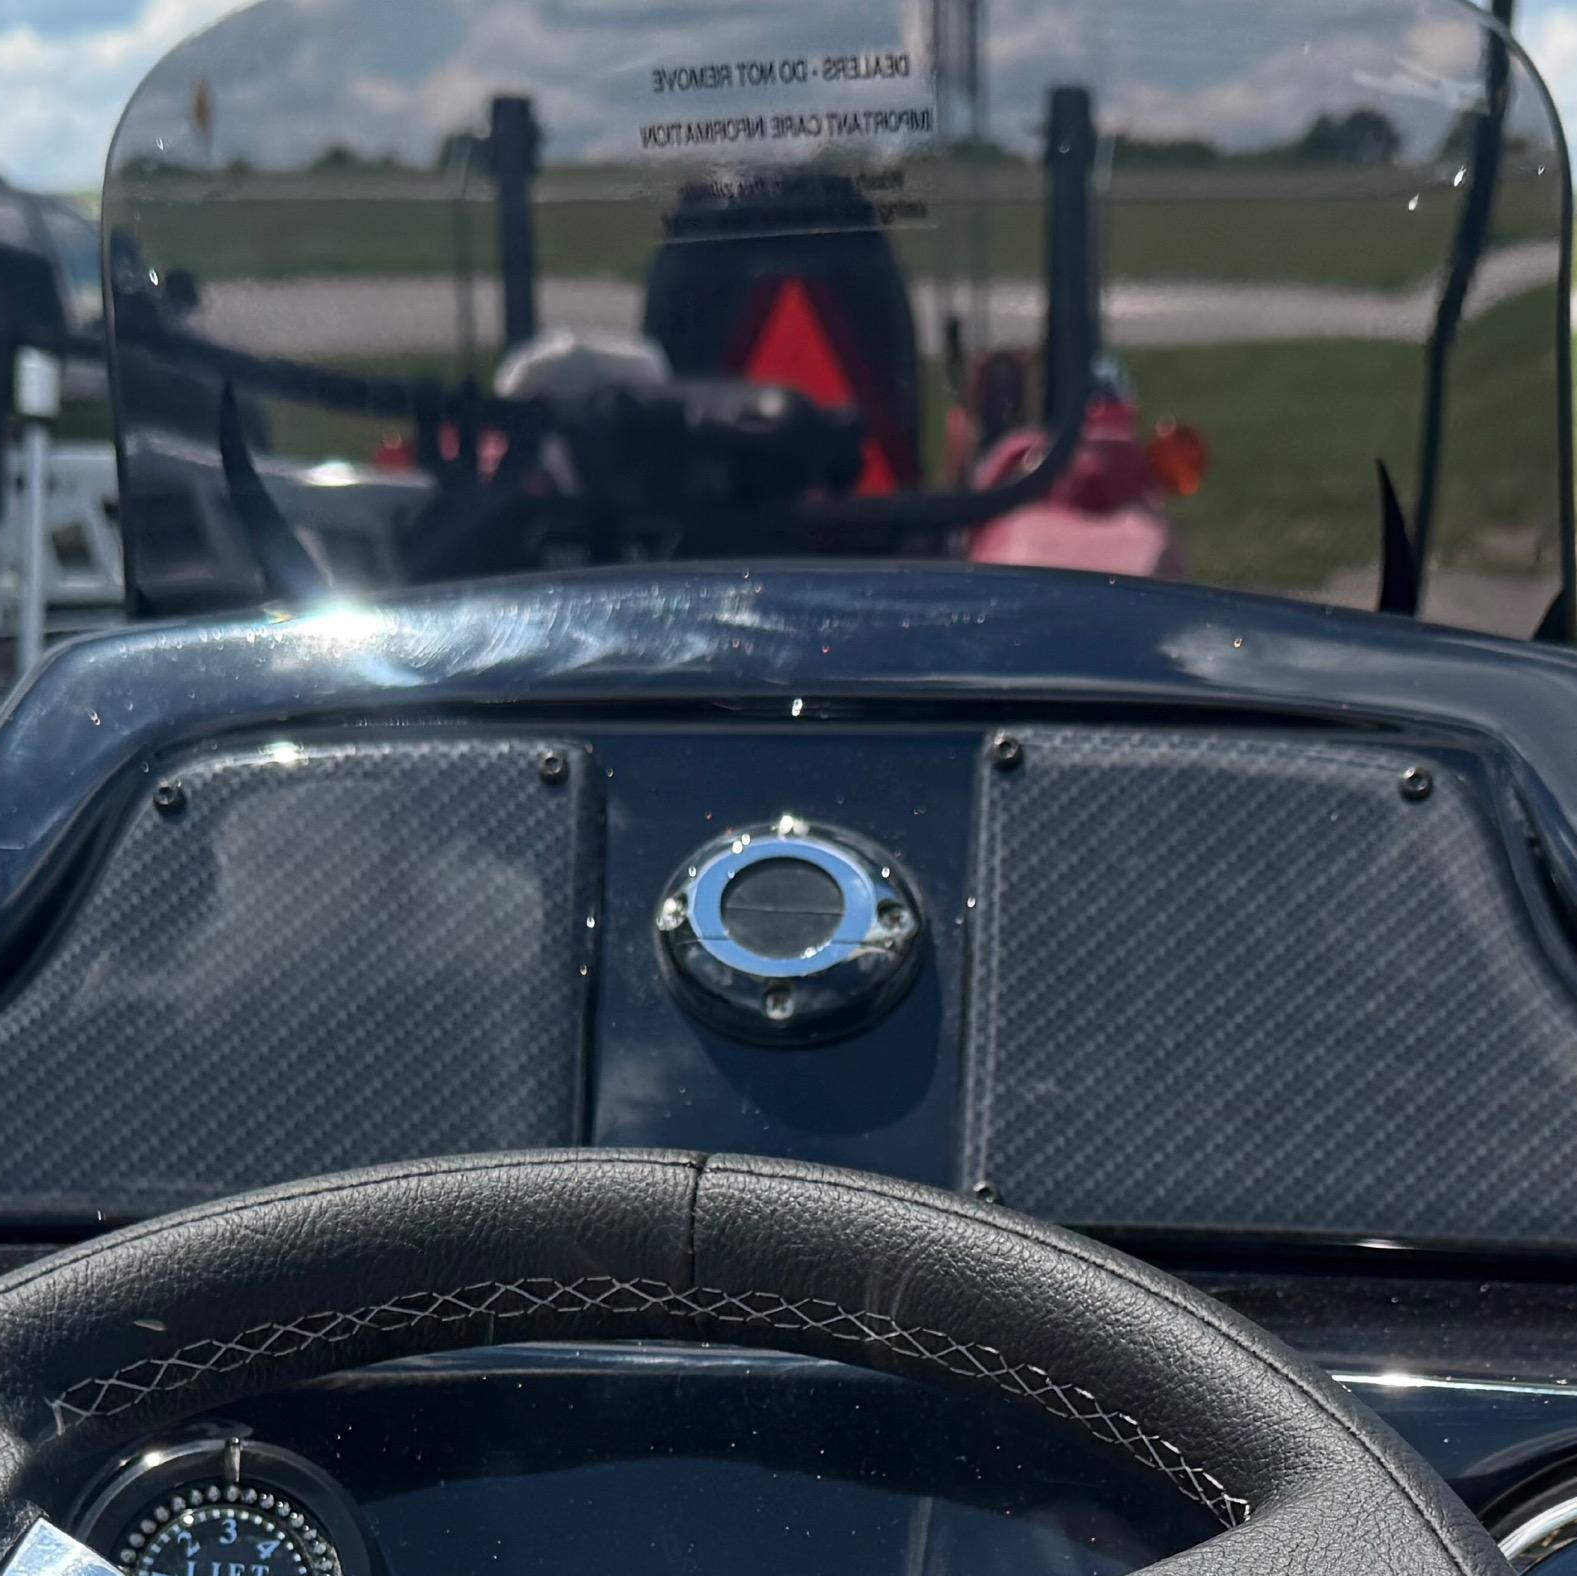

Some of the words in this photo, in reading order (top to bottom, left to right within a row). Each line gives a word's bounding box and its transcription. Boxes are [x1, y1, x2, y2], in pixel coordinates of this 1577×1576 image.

[177, 1531, 201, 1557] 2
[220, 1519, 238, 1544] 3
[256, 1539, 280, 1560] 4
